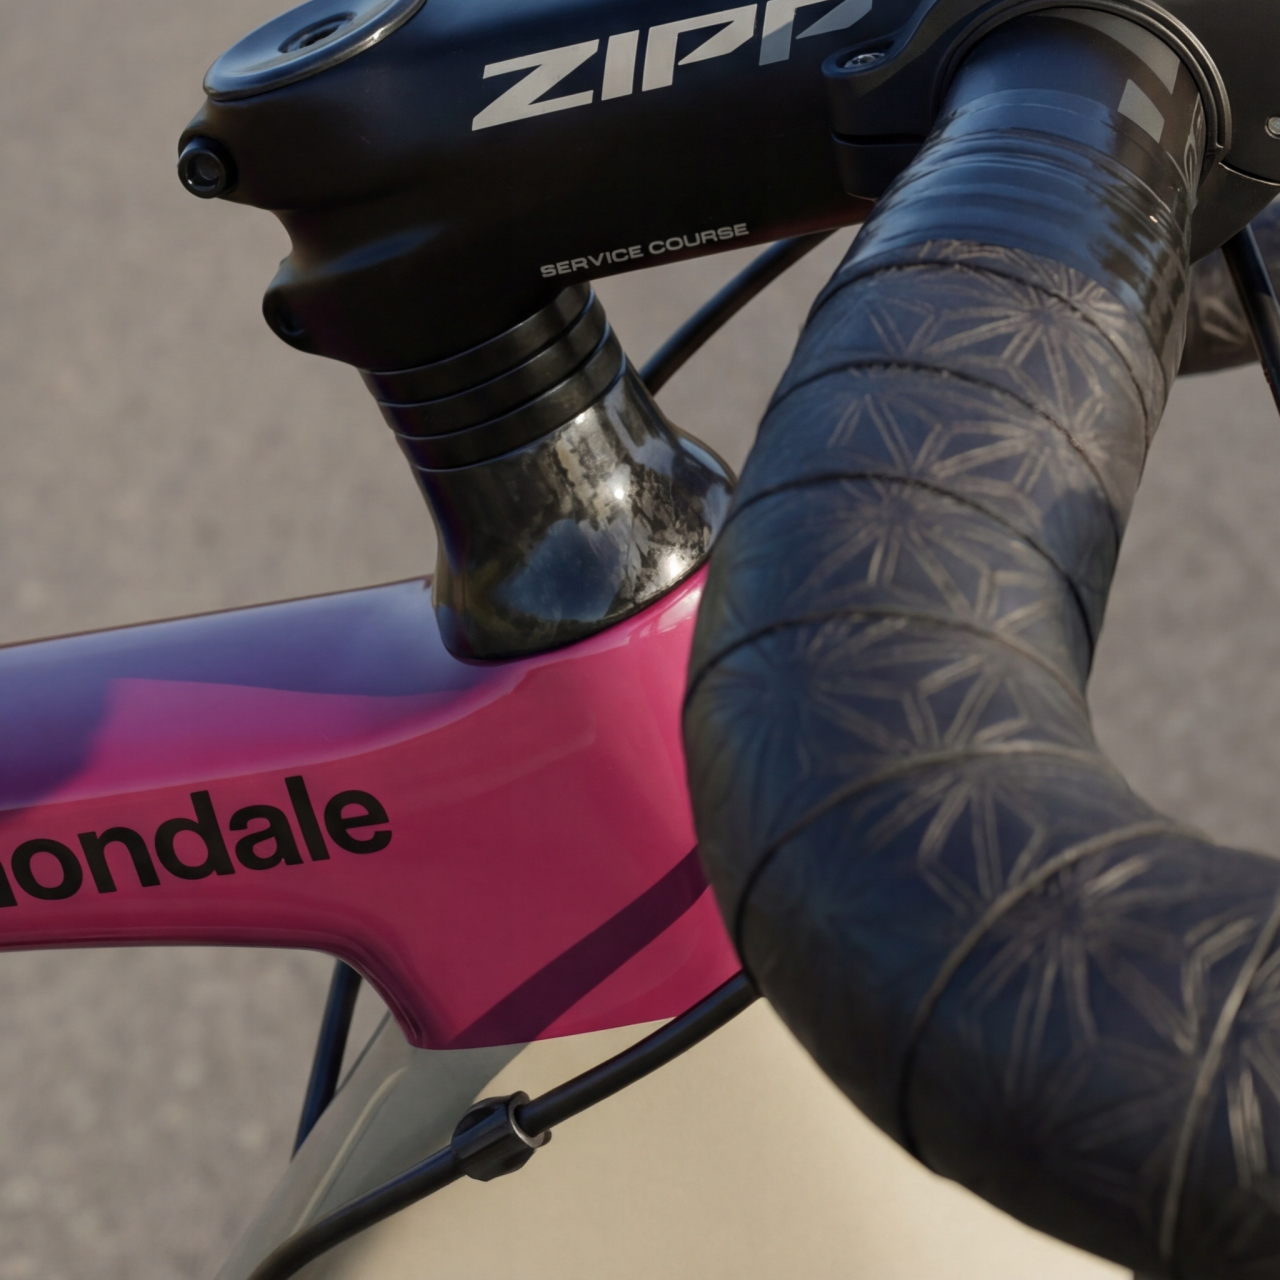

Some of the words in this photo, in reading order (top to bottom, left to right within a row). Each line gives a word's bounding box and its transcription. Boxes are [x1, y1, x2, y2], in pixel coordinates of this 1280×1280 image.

[540, 245, 644, 279] SERVICE
[648, 223, 749, 256] COURSE
[0, 775, 393, 908] ondale
